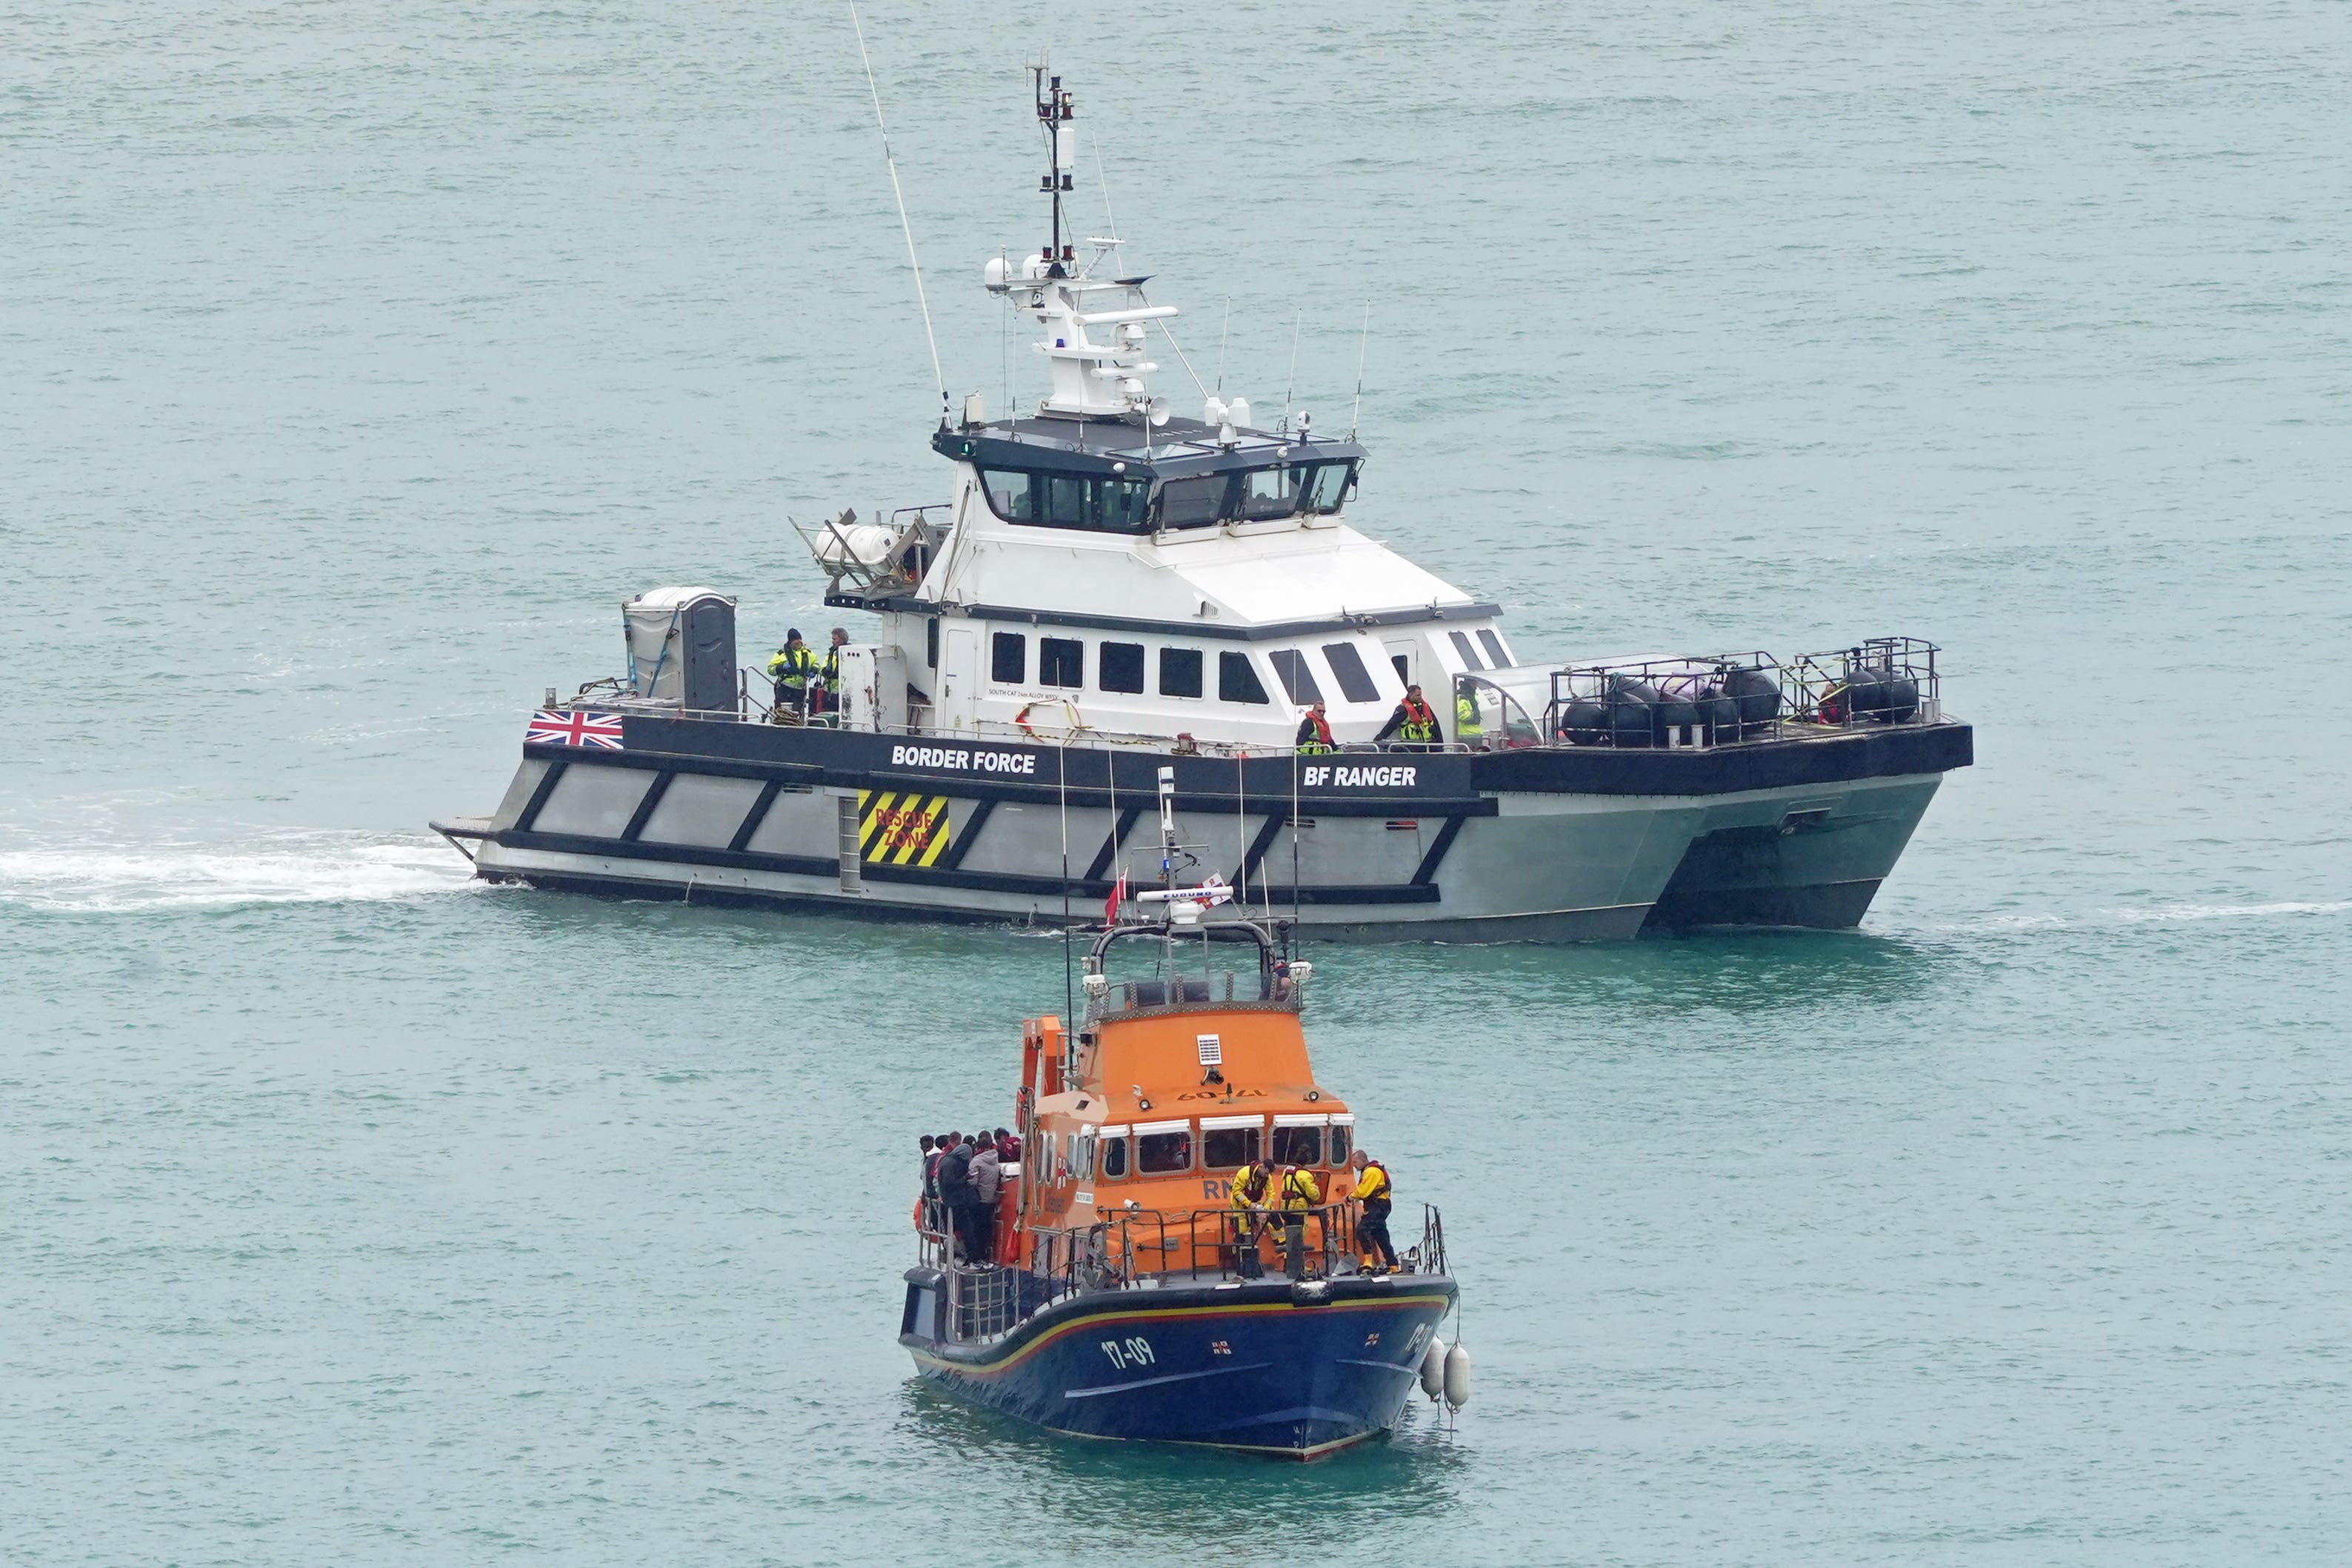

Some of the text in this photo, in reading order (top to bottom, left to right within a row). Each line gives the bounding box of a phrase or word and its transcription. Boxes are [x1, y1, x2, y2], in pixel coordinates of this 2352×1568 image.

[892, 745, 1036, 774] BORDER FORCE
[1304, 767, 1416, 786] BF RANGER
[876, 808, 932, 830] RESCUE
[885, 830, 929, 850] ZONE
[1203, 1178, 1233, 1199] RN
[1101, 1336, 1156, 1370] 17-09
